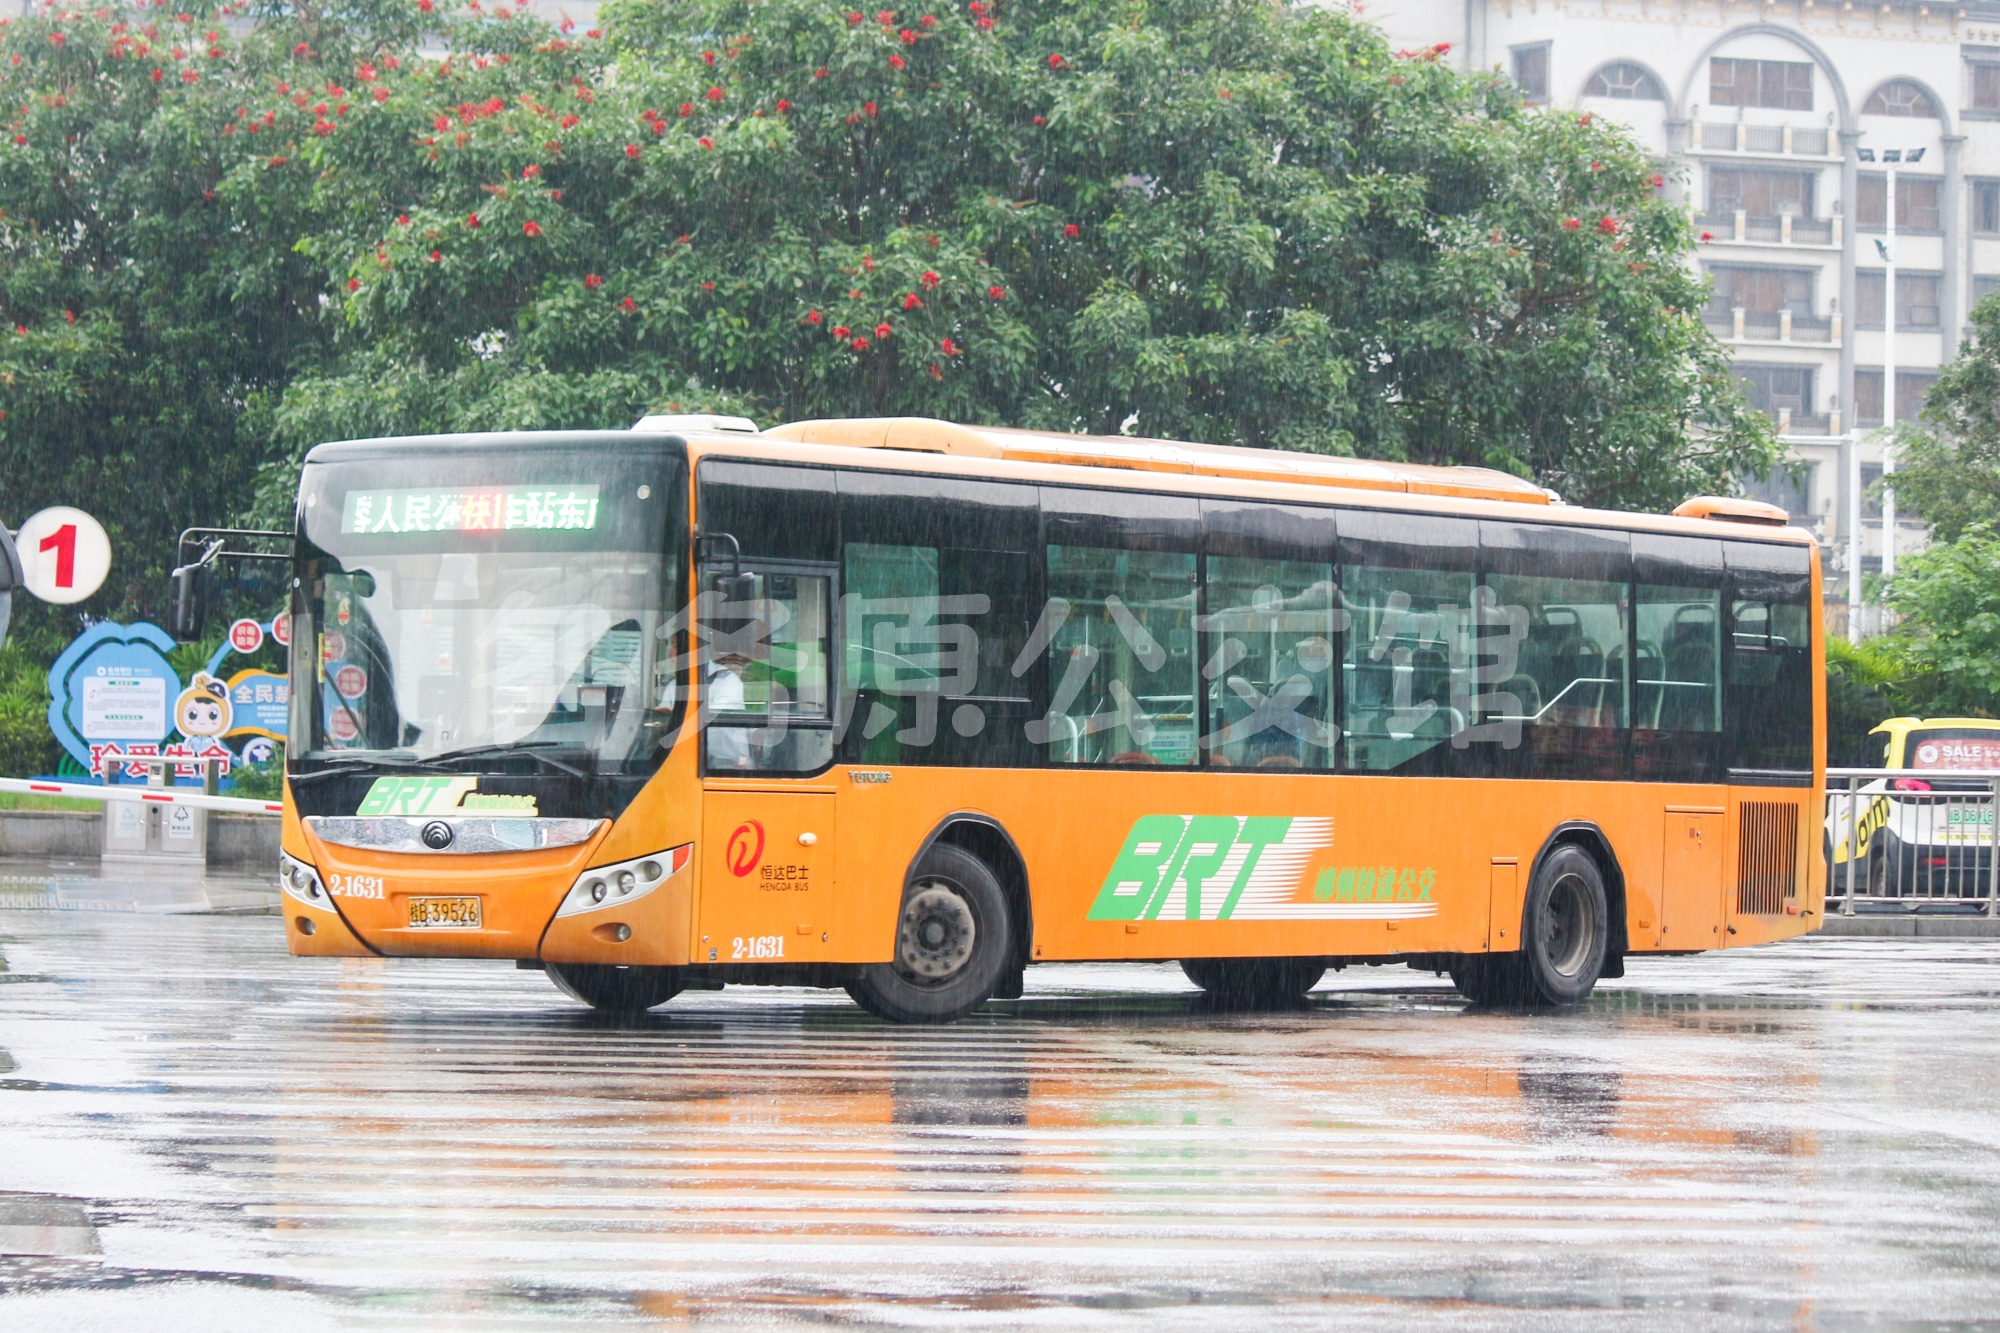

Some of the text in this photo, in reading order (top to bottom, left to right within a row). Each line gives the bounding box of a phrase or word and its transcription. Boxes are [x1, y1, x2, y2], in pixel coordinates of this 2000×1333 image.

[39, 524, 77, 588] 1
[1942, 745, 1982, 758] SALE
[848, 770, 892, 784] YUTONG
[357, 777, 453, 815] BRT
[761, 865, 810, 880] 恒达巴士
[1086, 814, 1294, 921] BRT
[330, 873, 386, 900] 2-1631
[760, 883, 810, 892] HENGDA BUS
[731, 936, 786, 959] 2-1631
